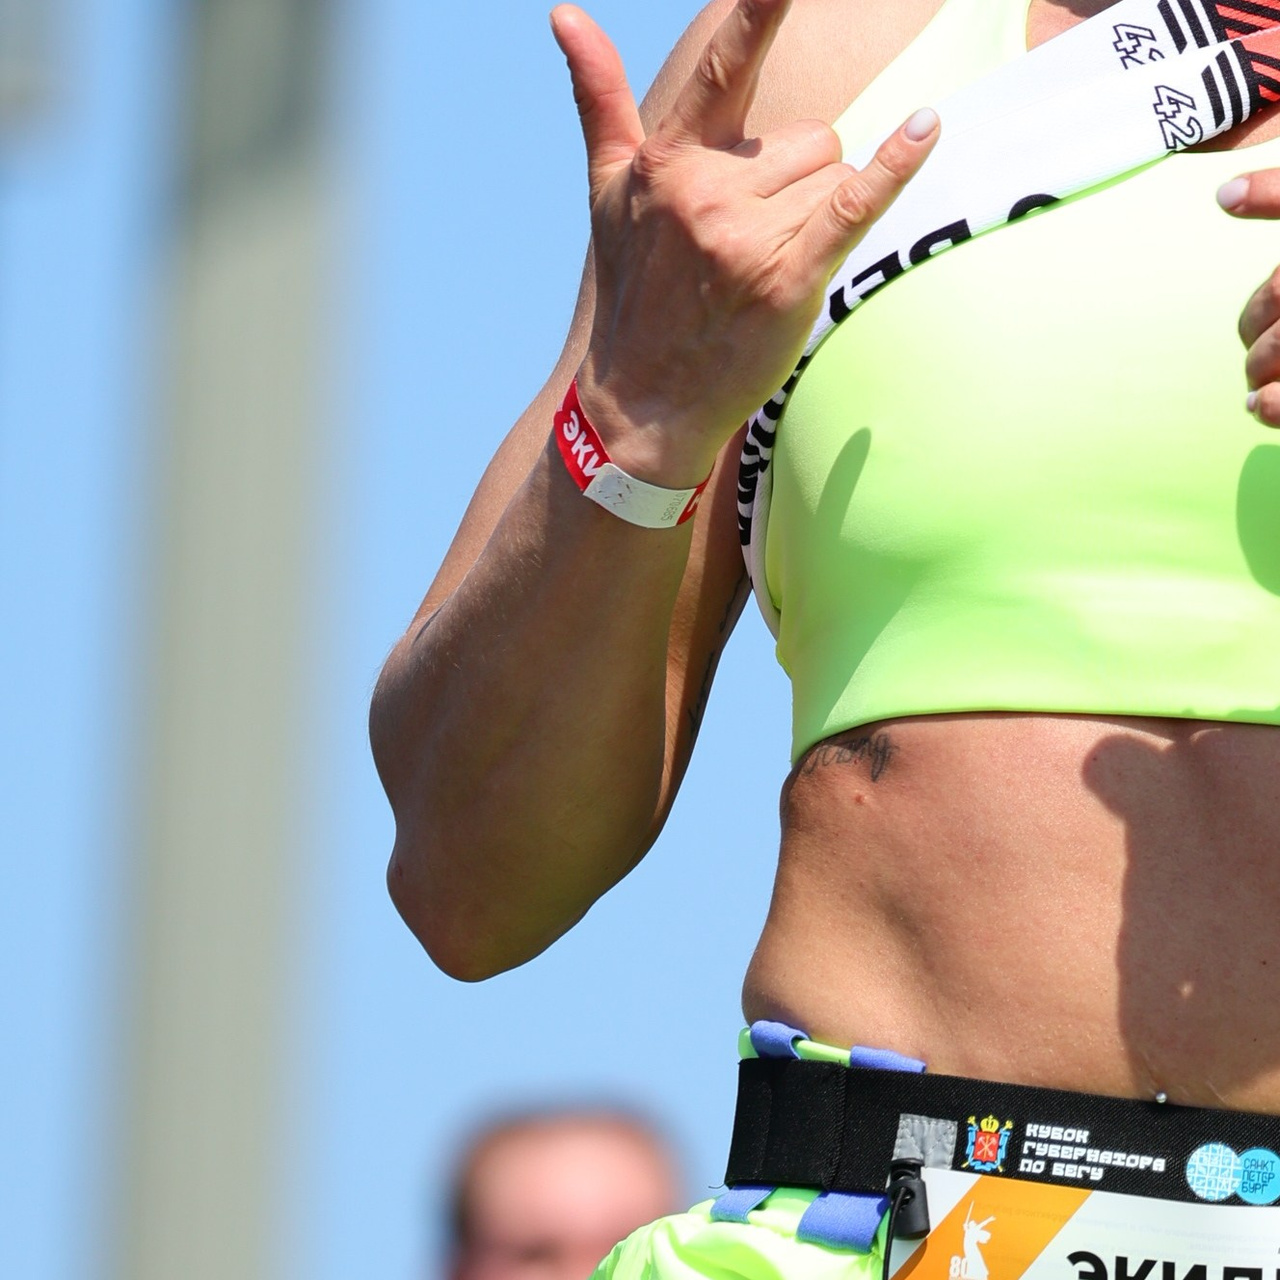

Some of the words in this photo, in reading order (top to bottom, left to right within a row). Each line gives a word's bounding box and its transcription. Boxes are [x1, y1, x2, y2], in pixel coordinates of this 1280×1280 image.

[1025, 1123, 1090, 1144] КУБОК
[1022, 1141, 1166, 1173] ГУБЕРНАТОРА
[1243, 1157, 1275, 1170] САНКТ
[1019, 1158, 1045, 1174] ПО
[1052, 1162, 1105, 1181] БЕГУ
[1242, 1171, 1275, 1183] ПЕТЕР
[1241, 1181, 1269, 1195] БУРГ
